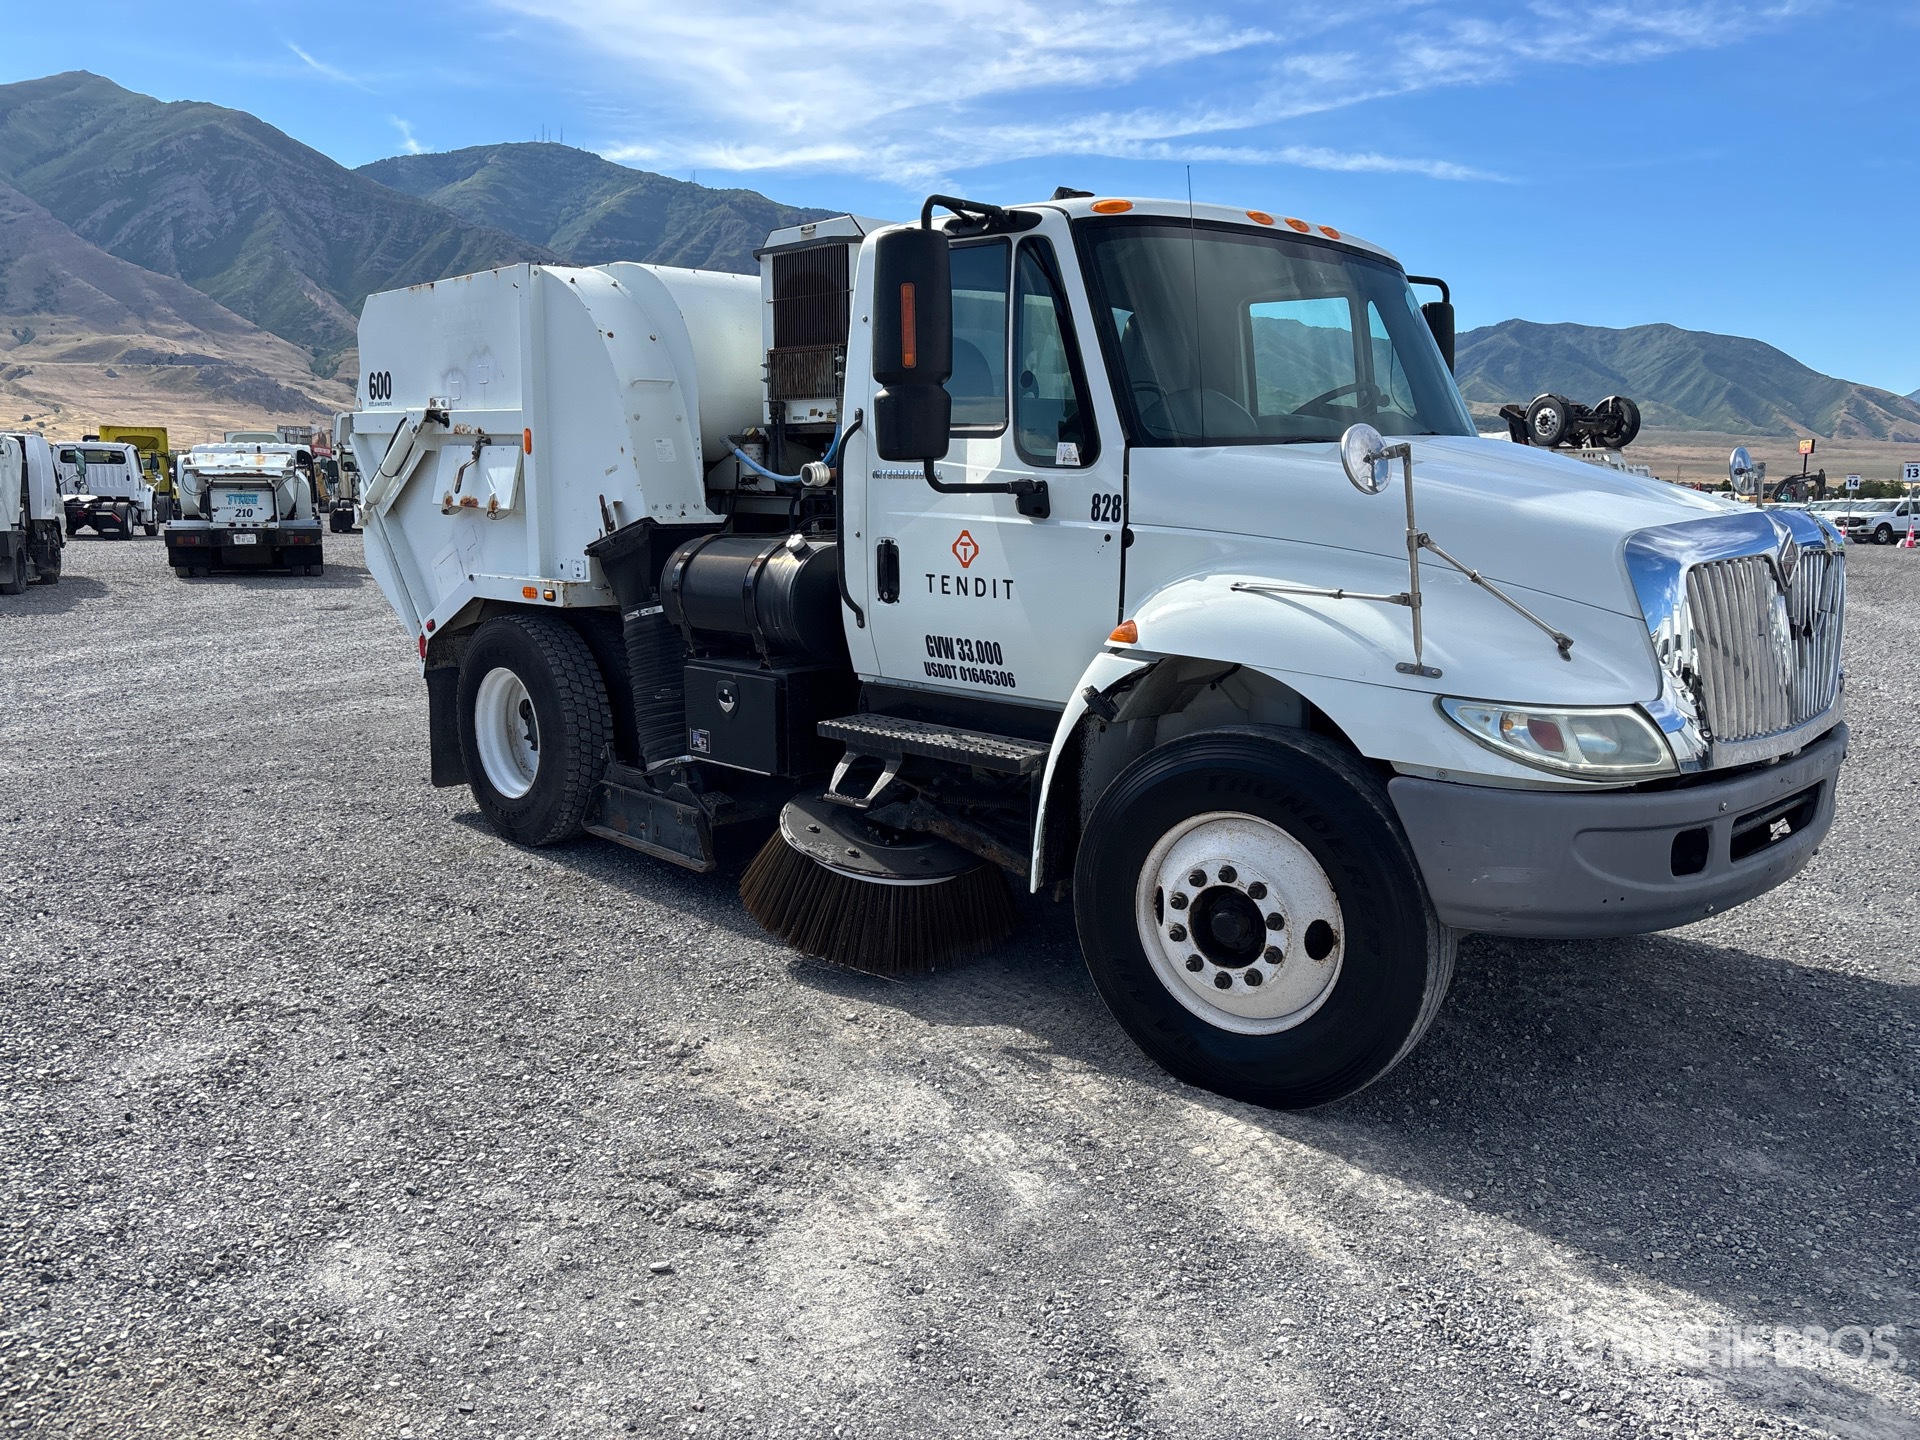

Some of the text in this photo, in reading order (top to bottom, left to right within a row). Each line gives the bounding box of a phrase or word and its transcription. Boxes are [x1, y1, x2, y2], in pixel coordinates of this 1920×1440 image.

[369, 371, 392, 400] 600
[1906, 469, 1919, 478] 13
[235, 508, 253, 517] 210
[1091, 494, 1122, 522] 828
[925, 574, 1014, 600] TENDIT
[925, 635, 1003, 666] GVW 33,000
[924, 661, 1016, 688] USDOT 01646306
